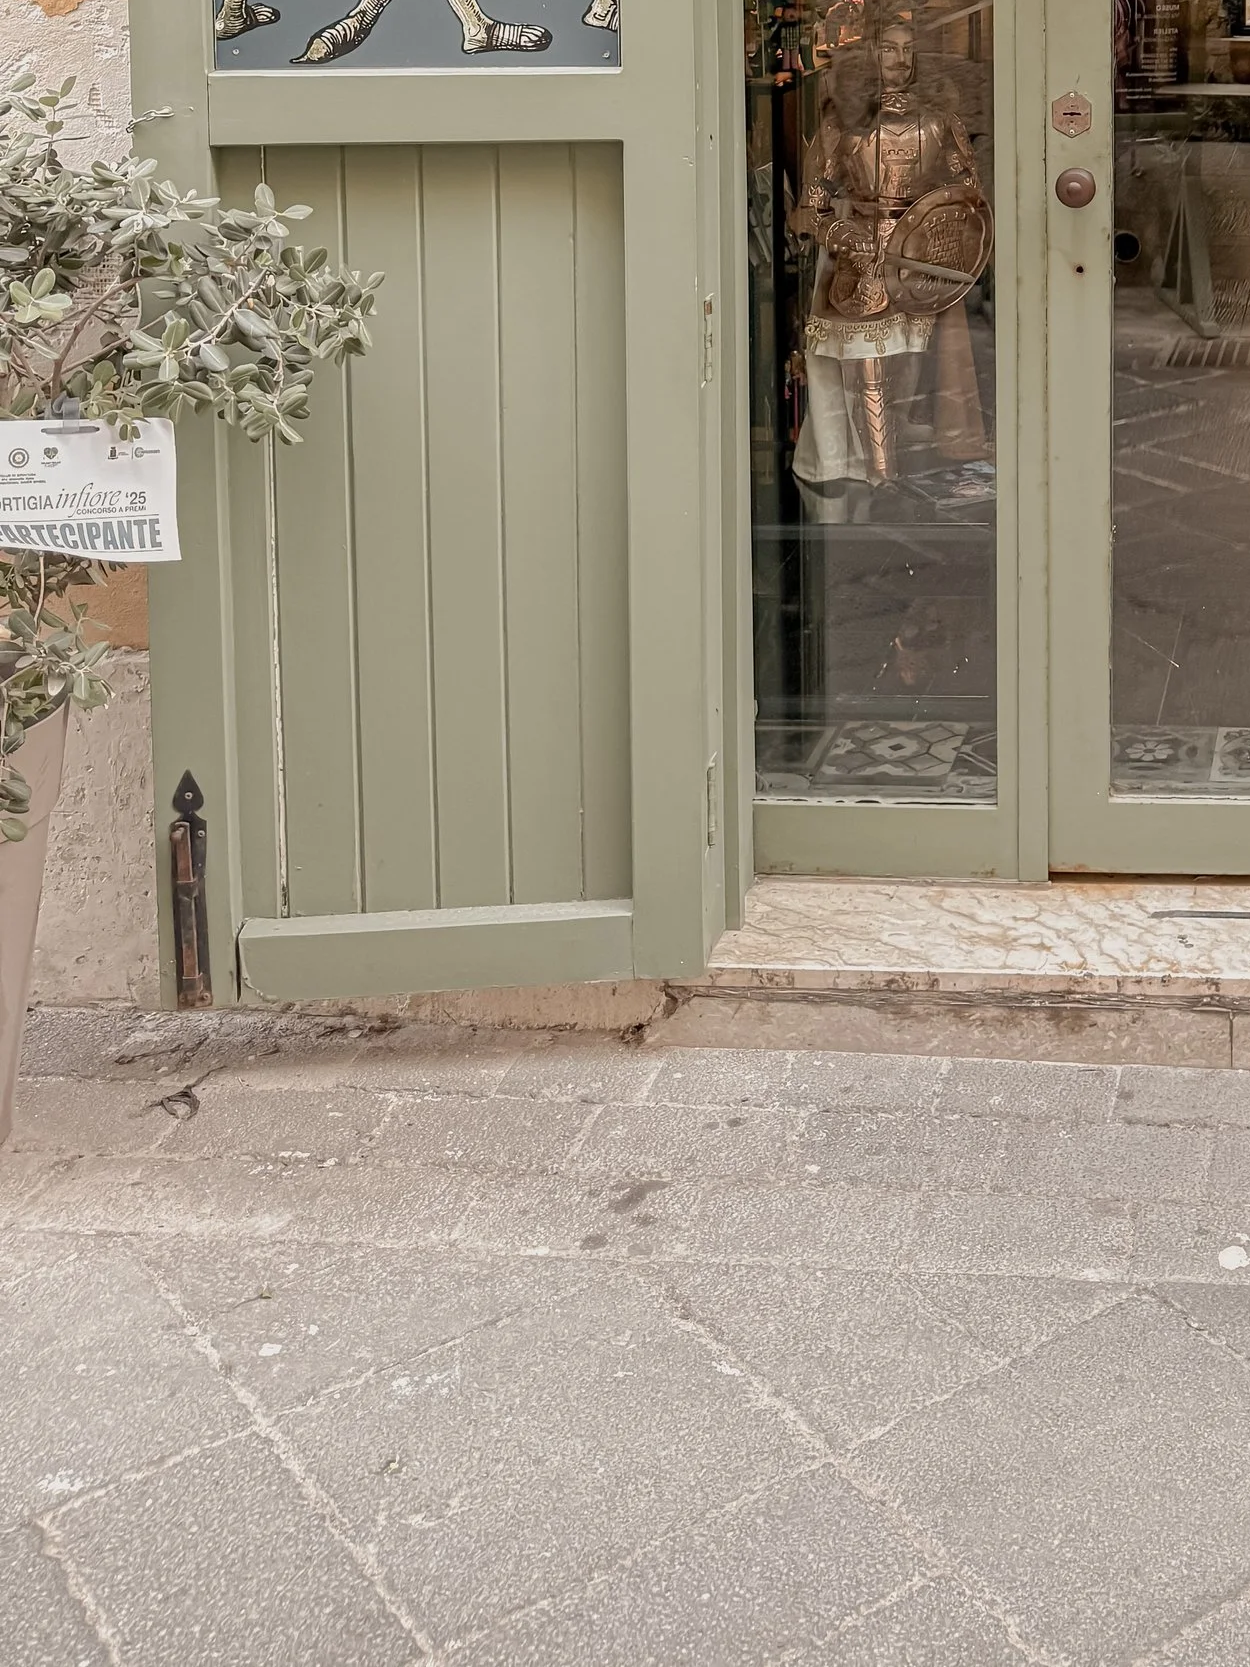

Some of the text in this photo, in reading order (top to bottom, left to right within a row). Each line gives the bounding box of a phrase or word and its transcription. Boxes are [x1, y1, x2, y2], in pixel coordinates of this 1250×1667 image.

[0, 494, 53, 512] RTIGIA
[55, 482, 122, 518] infiore
[77, 506, 117, 515] CONCORSO
[125, 505, 147, 513] PREMI
[0, 518, 163, 551] ARTECIPANTE
